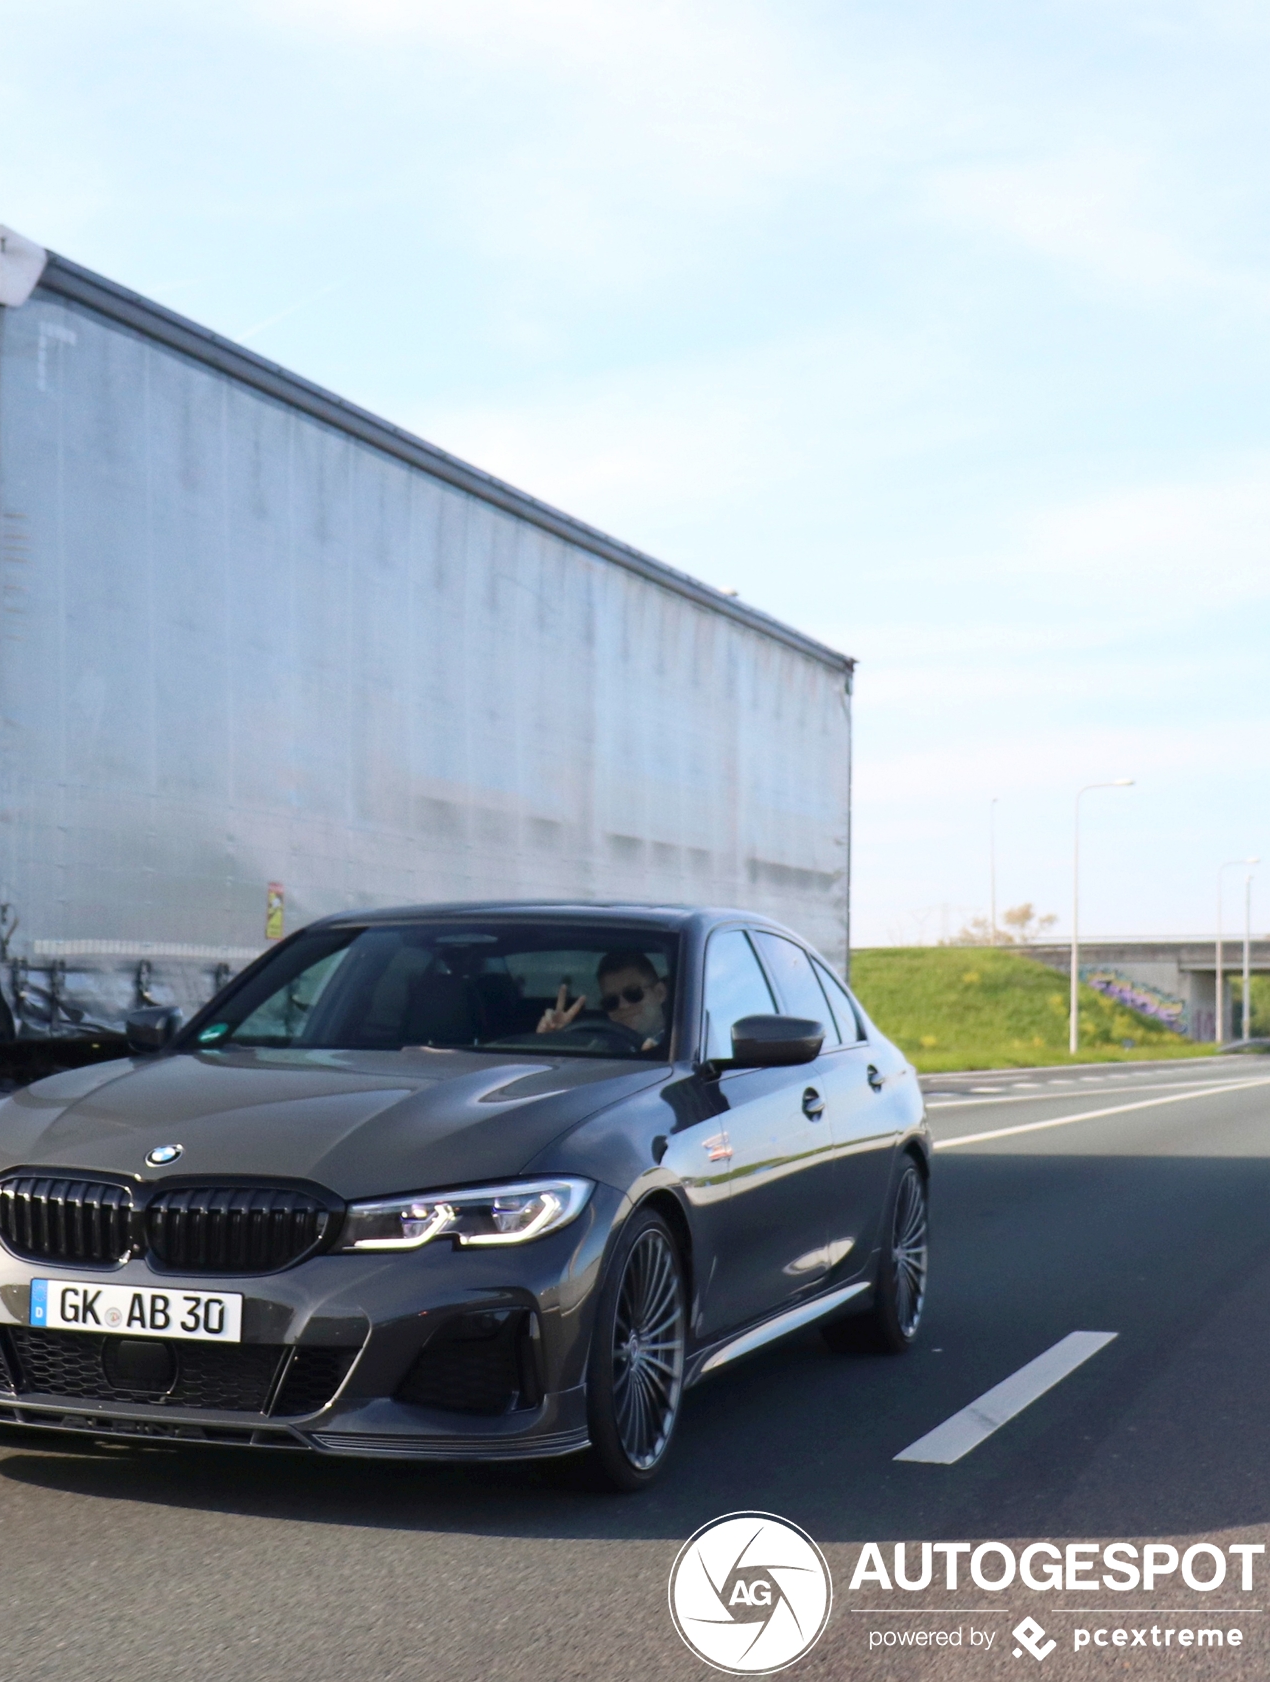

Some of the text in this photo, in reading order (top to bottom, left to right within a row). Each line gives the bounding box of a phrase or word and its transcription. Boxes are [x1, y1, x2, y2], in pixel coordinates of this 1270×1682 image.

[35, 1306, 43, 1318] D
[60, 1287, 224, 1334] GK AB 30
